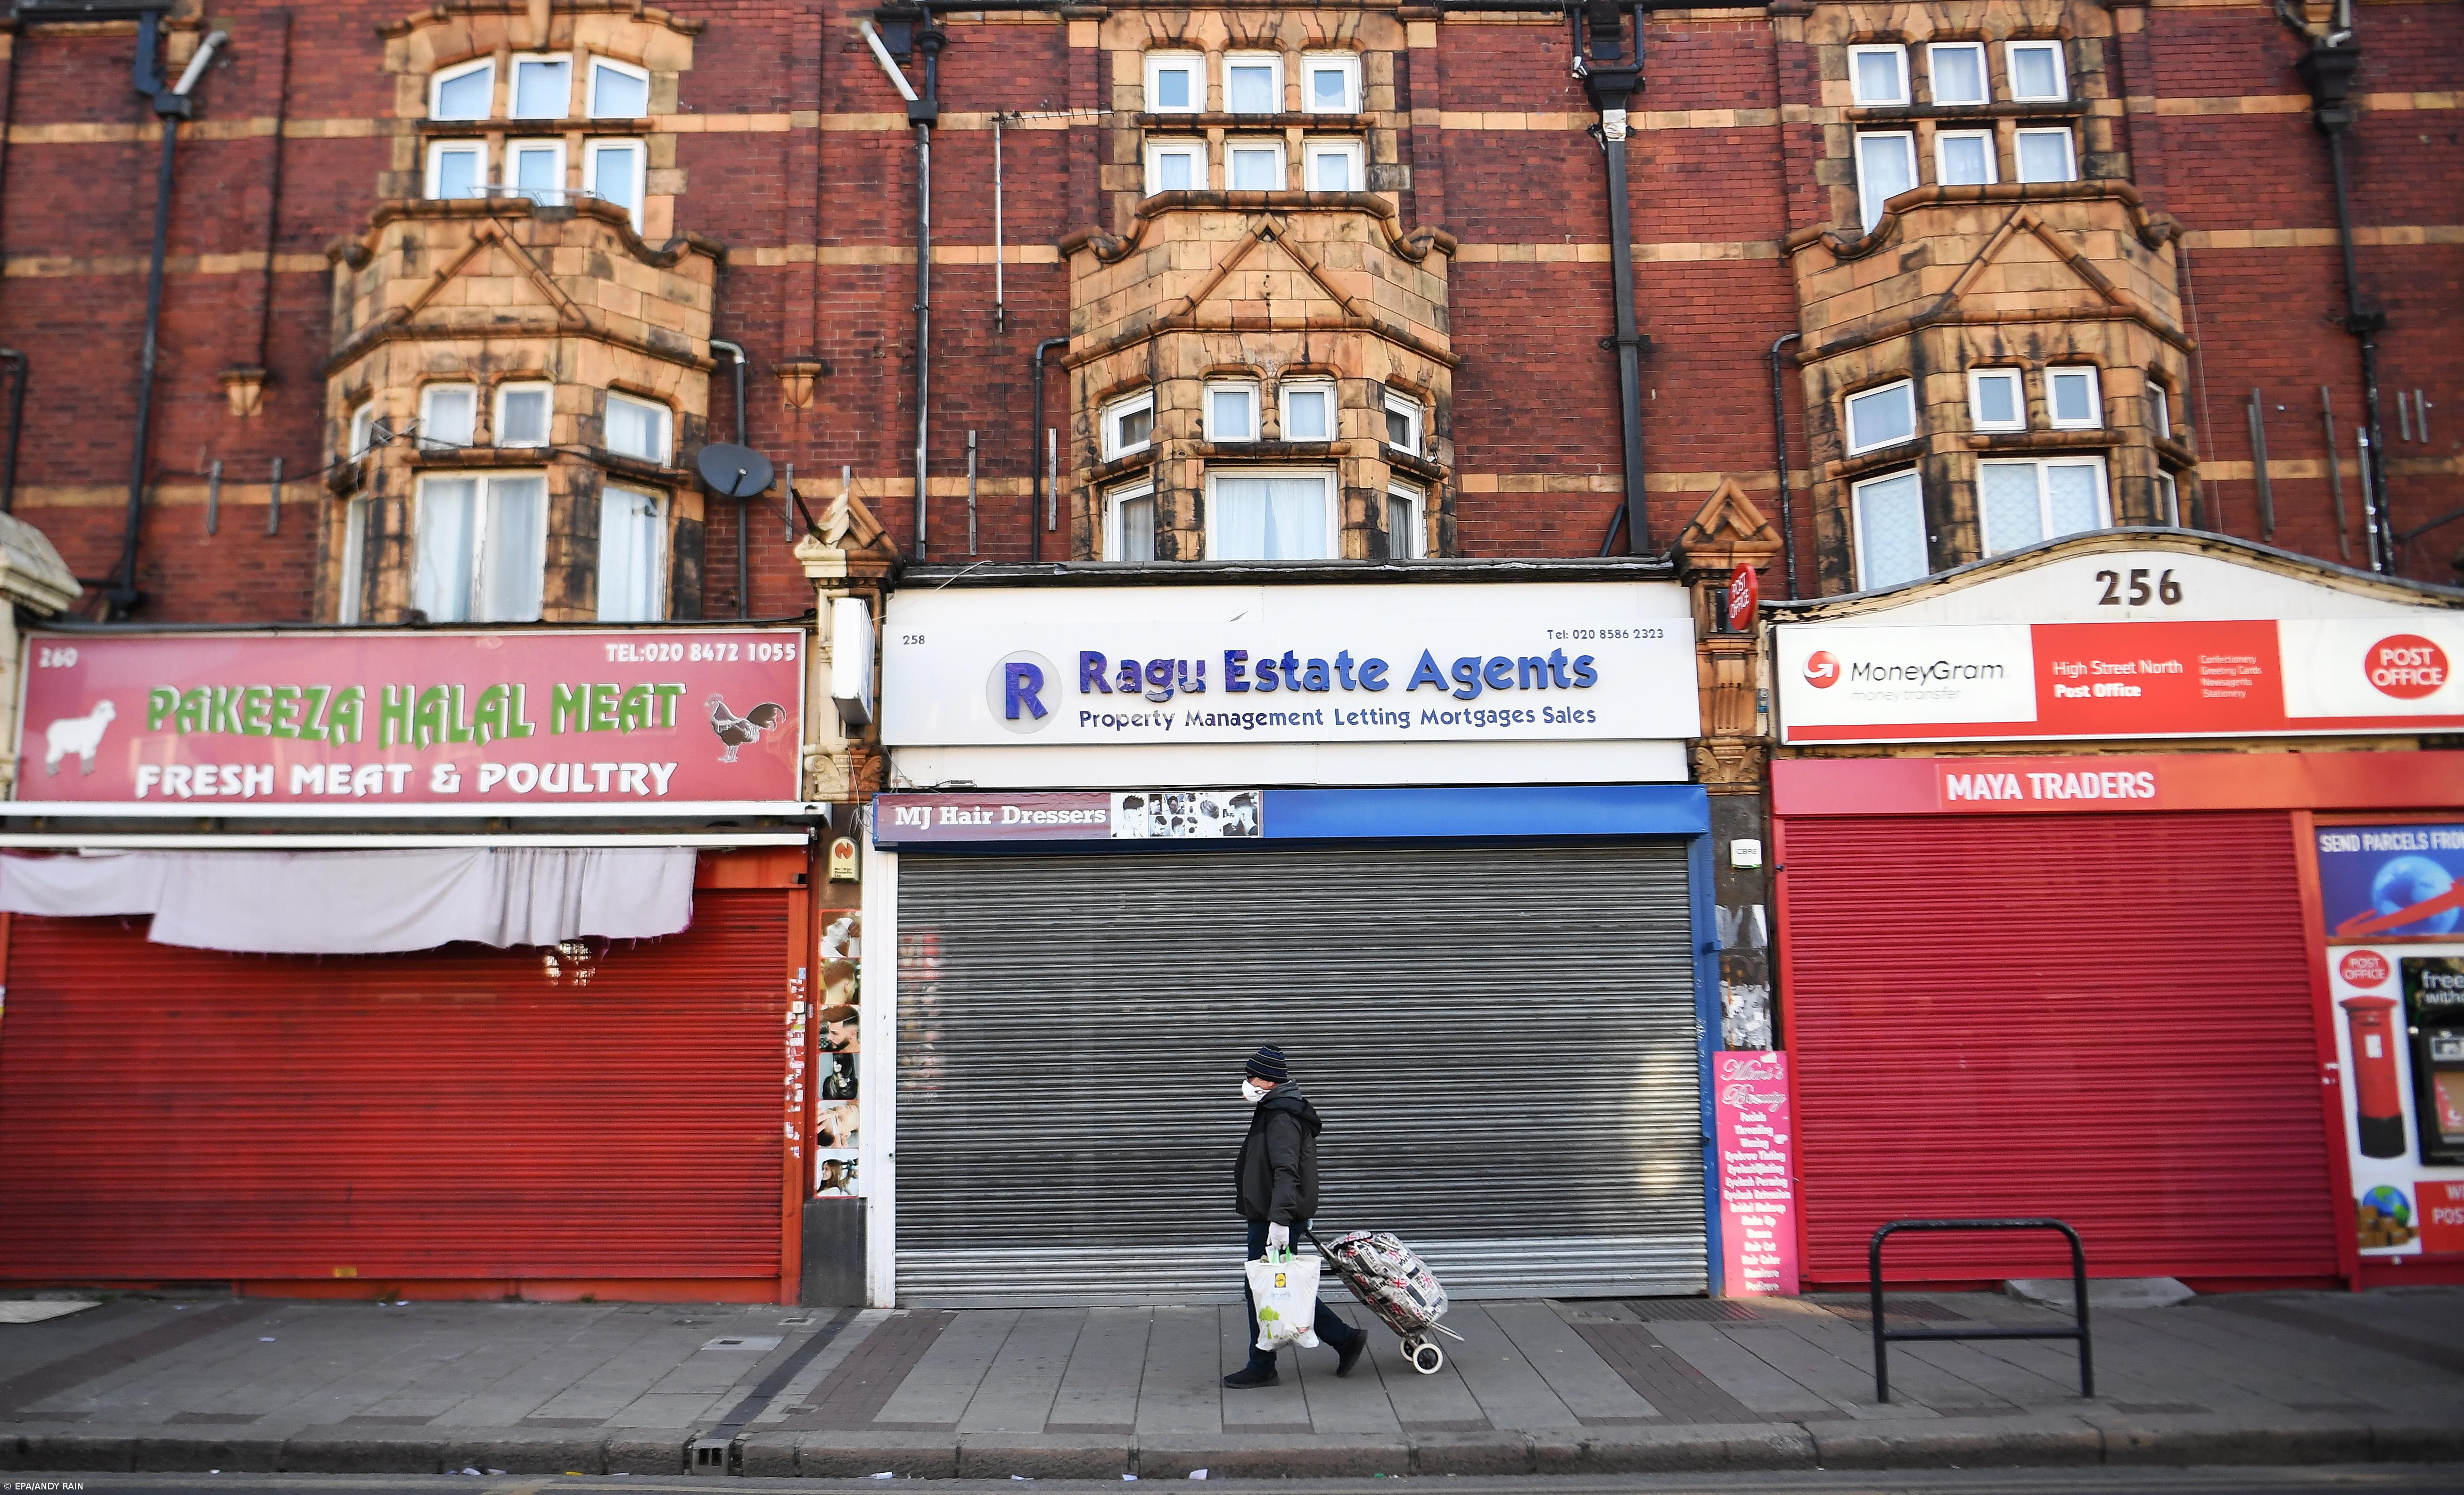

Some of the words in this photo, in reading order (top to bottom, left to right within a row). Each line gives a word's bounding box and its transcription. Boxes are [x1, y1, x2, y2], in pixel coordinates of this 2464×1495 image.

[1732, 572, 1746, 599] POST
[2095, 568, 2183, 606] 256
[1729, 589, 1749, 619] OFFICE
[903, 634, 925, 646] 258
[1547, 629, 1569, 640] Tel:
[1572, 629, 1595, 640] 020
[1599, 629, 1629, 639] 8586
[1633, 629, 1664, 639] 2323
[40, 647, 78, 668] 260
[607, 644, 683, 662] TEL:020
[691, 643, 739, 661] 8472
[748, 643, 796, 661] 1055
[2200, 655, 2257, 665] Confectionery
[2379, 648, 2435, 666] POST
[1079, 650, 1206, 703] Ragu
[1224, 649, 1391, 693] Estate
[1406, 648, 1599, 701] Agents
[1851, 660, 2005, 686] MoneyGram
[2053, 660, 2090, 679] High
[2093, 660, 2137, 675] Street
[2139, 660, 2183, 674] North
[2201, 666, 2237, 676] Greeting
[2239, 666, 2263, 674] Cards
[2372, 667, 2444, 686] OFFICE
[1005, 662, 1048, 720] R
[2053, 684, 2091, 698] Post
[2093, 682, 2141, 698] Office
[2201, 678, 2252, 688] Newsagents
[1852, 690, 1902, 702] money
[1903, 687, 1962, 700] transfer
[2202, 689, 2246, 699] Stationery
[147, 684, 366, 748] PAKEEZA
[379, 683, 535, 751] HALAL
[551, 683, 687, 736] MEAT
[1080, 710, 1175, 731] Property
[1185, 709, 1324, 731] Management
[1335, 708, 1410, 729] Letting
[1421, 707, 1536, 728] Mortgages
[1543, 706, 1597, 724] Sales
[135, 764, 274, 799] FRESH
[290, 764, 413, 798] MEAT
[431, 764, 461, 794] &
[479, 763, 678, 796] POULTRY
[1946, 772, 2023, 801] MAYA
[2026, 771, 2155, 800] TRADERS
[895, 806, 932, 830] MJ
[939, 805, 994, 826] Hair
[1002, 804, 1106, 825] Dressers
[2319, 835, 2360, 853] SEND
[2362, 833, 2429, 851] PARCELS
[2350, 958, 2381, 969] POST
[2345, 969, 2385, 980] OFFICE
[1734, 1124, 1774, 1137] Threading
[1725, 1176, 1755, 1189] Eyelash
[1723, 1189, 1754, 1202] Eyelash
[1743, 1267, 1780, 1278] Manicure
[1744, 1280, 1779, 1291] Pedicure
